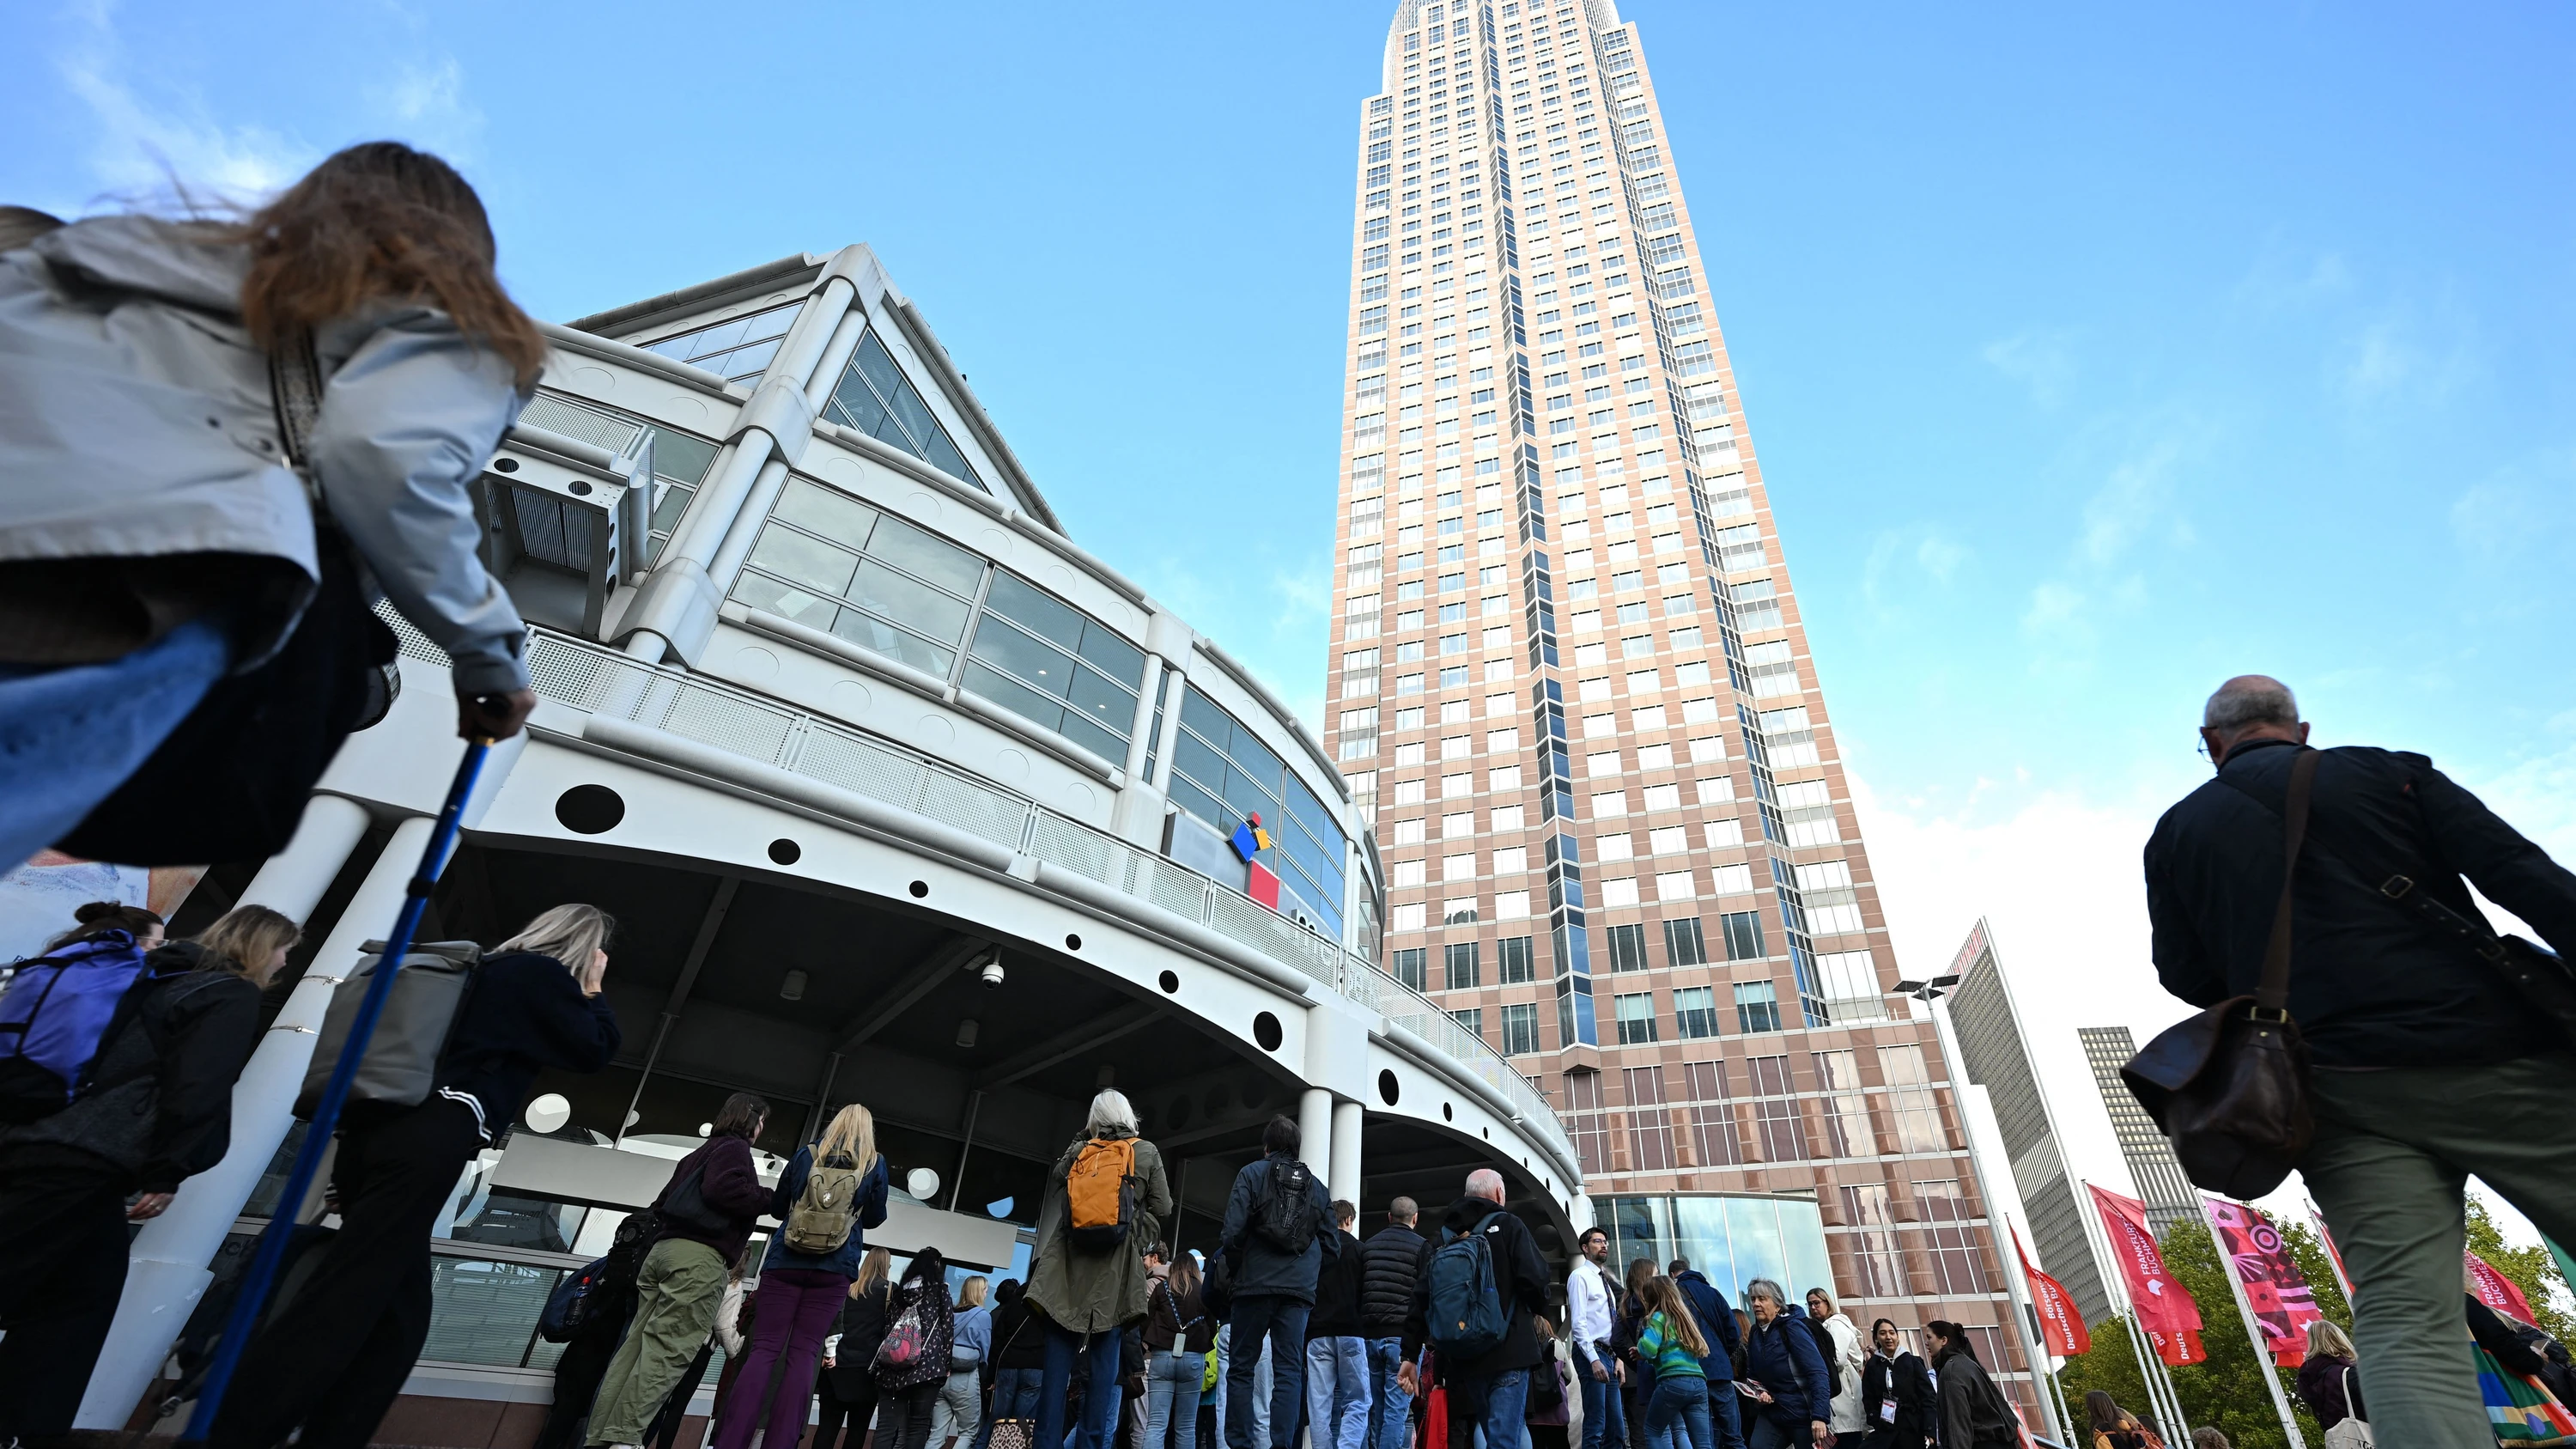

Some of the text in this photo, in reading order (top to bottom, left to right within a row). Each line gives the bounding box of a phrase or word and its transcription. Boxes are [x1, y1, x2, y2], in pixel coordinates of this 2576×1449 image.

[2119, 1215, 2152, 1275] FRANKFURT
[2055, 1301, 2076, 1349] Deutschen
[2175, 1331, 2190, 1360] Deuts
